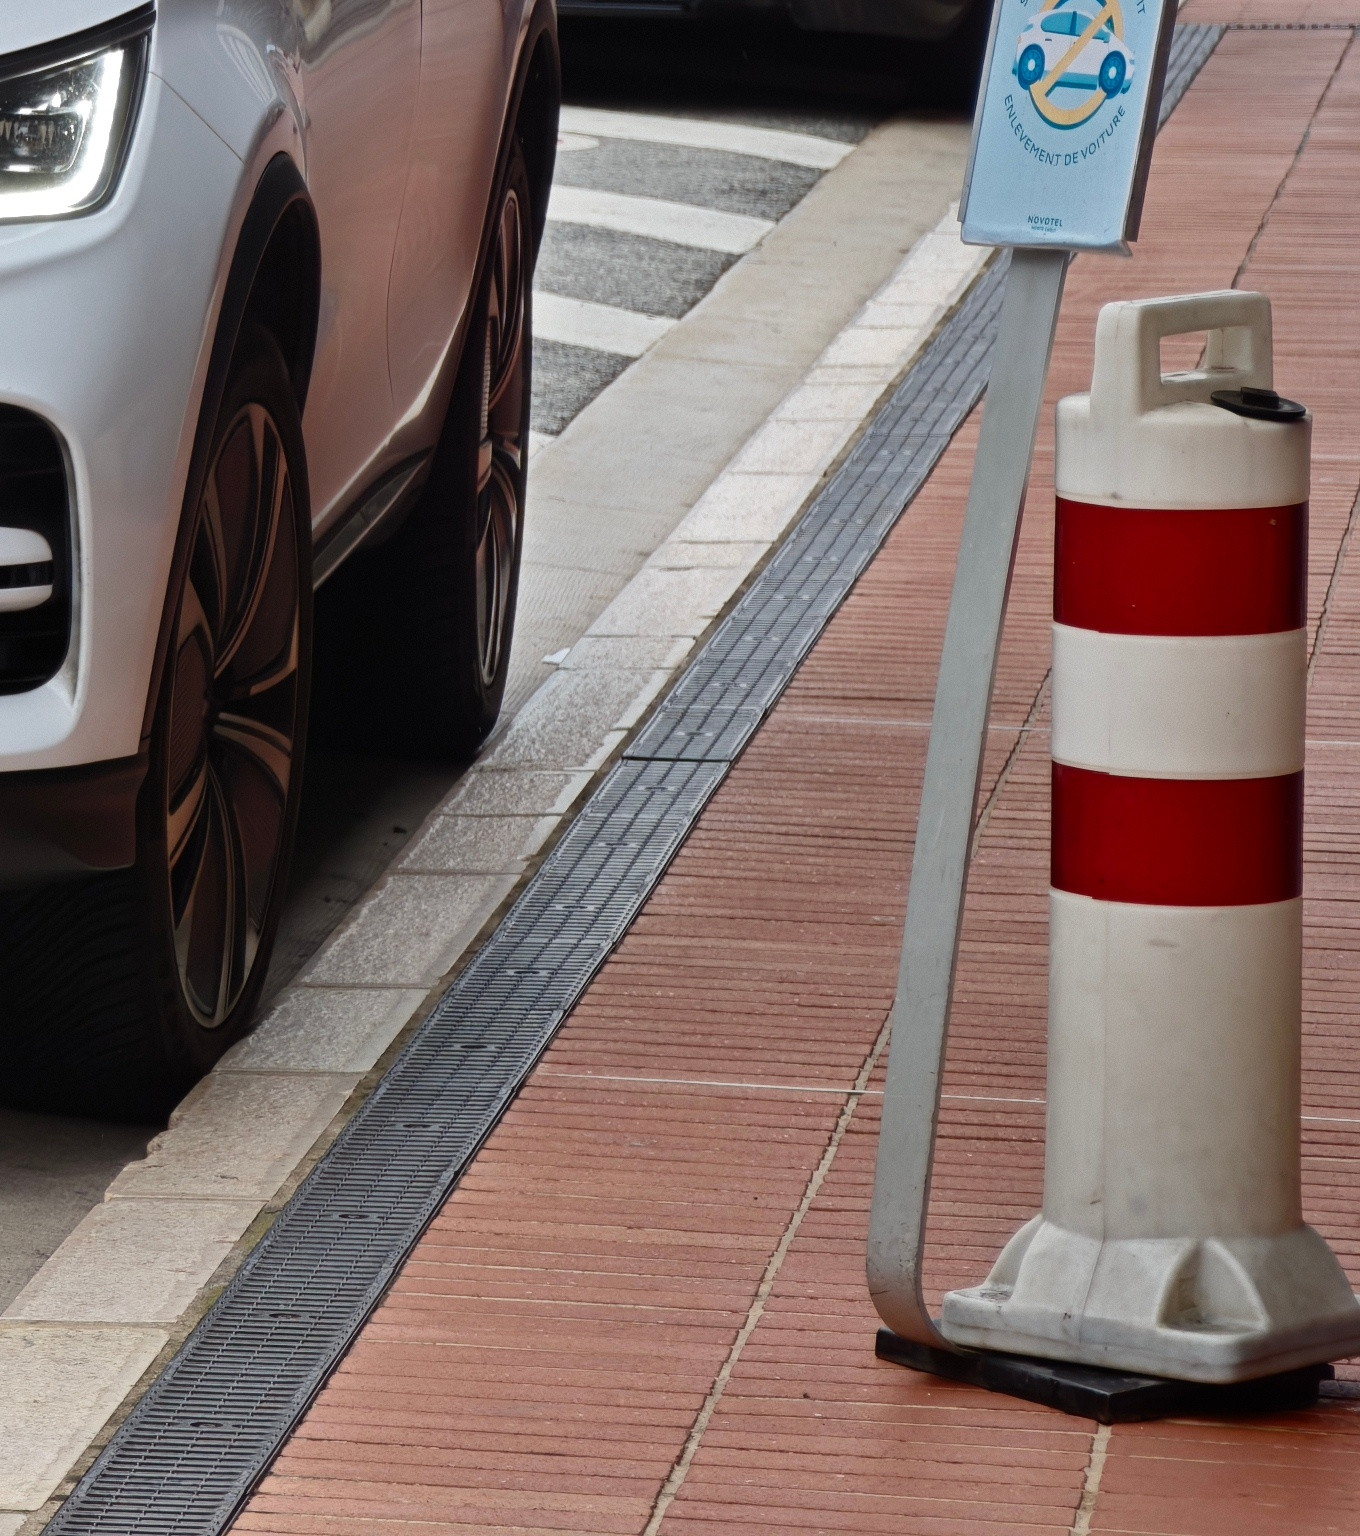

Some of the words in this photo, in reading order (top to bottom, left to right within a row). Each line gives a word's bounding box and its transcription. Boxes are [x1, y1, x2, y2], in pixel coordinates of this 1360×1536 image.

[1004, 94, 1062, 166] ENLEVEMENT
[1064, 151, 1079, 166] DE
[1080, 105, 1126, 160] VOITURE
[1027, 215, 1063, 227] NOVOTEL
